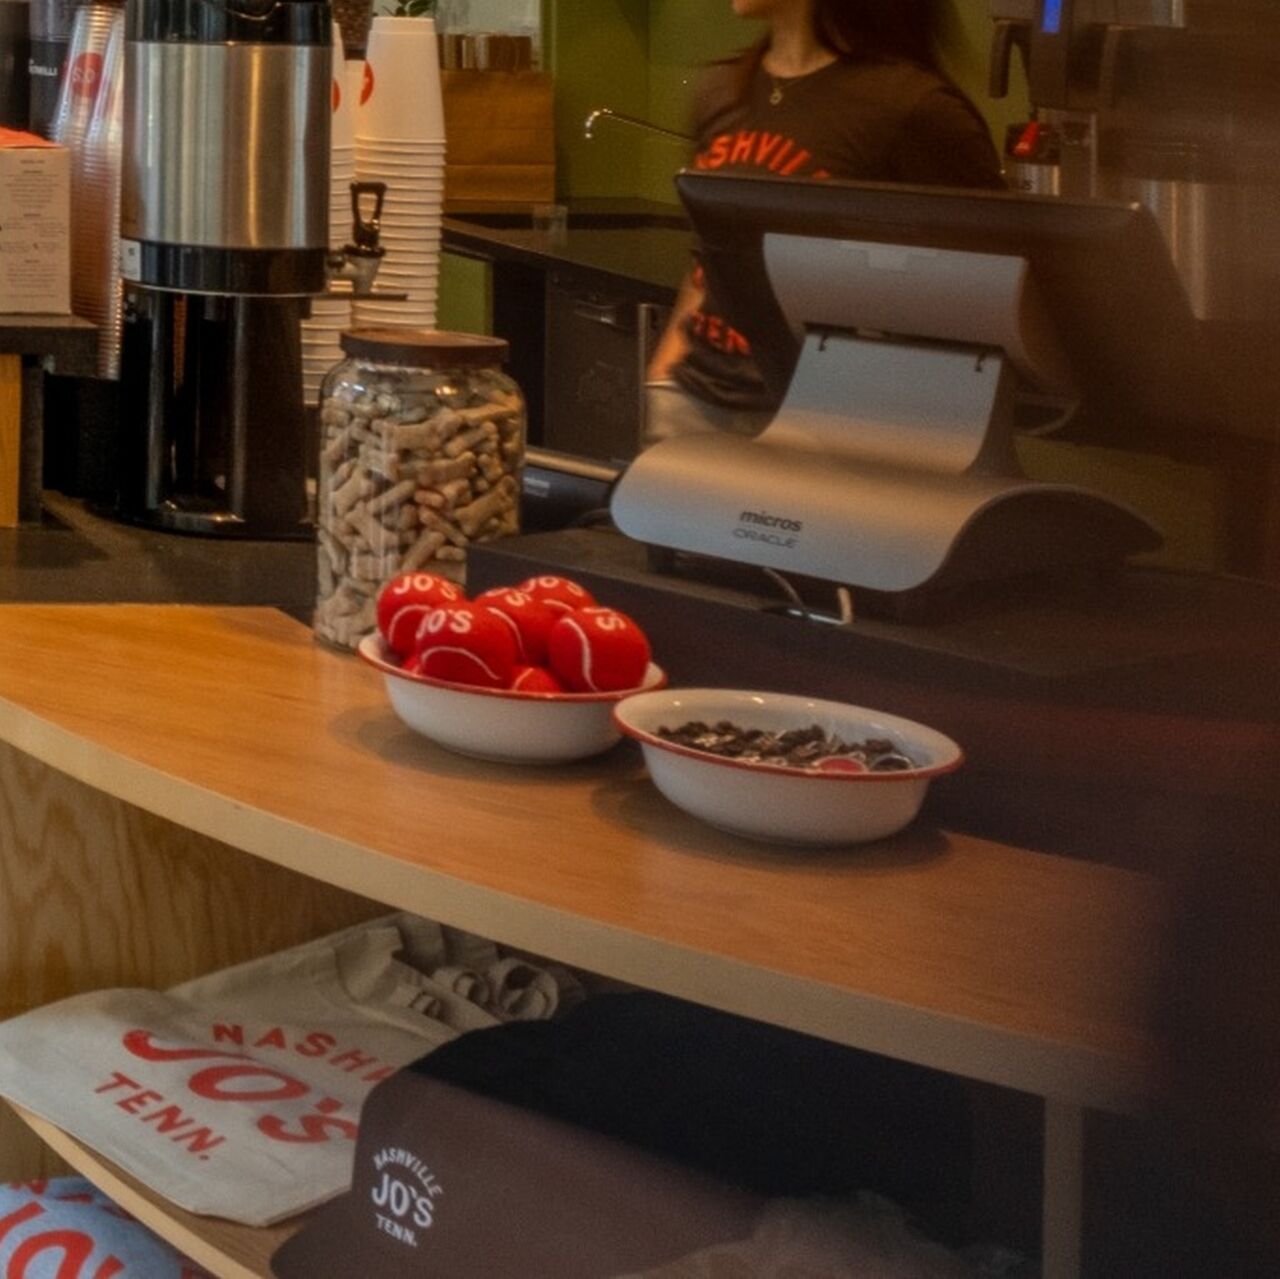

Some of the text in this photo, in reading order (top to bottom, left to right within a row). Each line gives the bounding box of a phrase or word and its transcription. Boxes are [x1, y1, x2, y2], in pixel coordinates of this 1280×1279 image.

[739, 510, 802, 532] micros
[393, 575, 458, 600] JO'S
[122, 1029, 359, 1144] JO'S
[95, 1071, 226, 1161] TENN.
[373, 1147, 443, 1197] NASHVILLE
[372, 1173, 434, 1228] JO'S
[375, 1213, 417, 1248] TENN.
